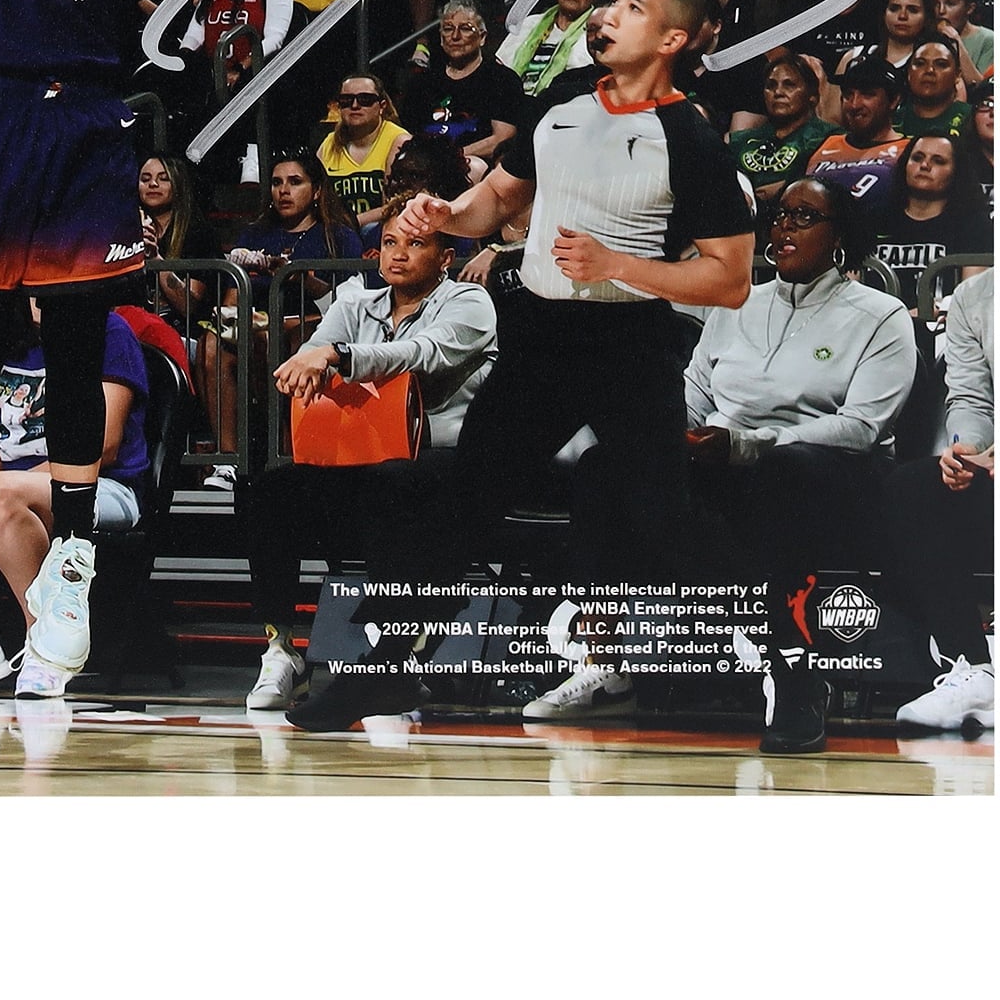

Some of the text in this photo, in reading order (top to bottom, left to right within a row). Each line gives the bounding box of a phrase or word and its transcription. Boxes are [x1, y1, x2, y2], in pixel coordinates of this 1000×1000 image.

[207, 10, 249, 25] USA
[334, 176, 384, 197] EATTL
[850, 173, 880, 199] 9
[874, 243, 947, 269] EATTLE
